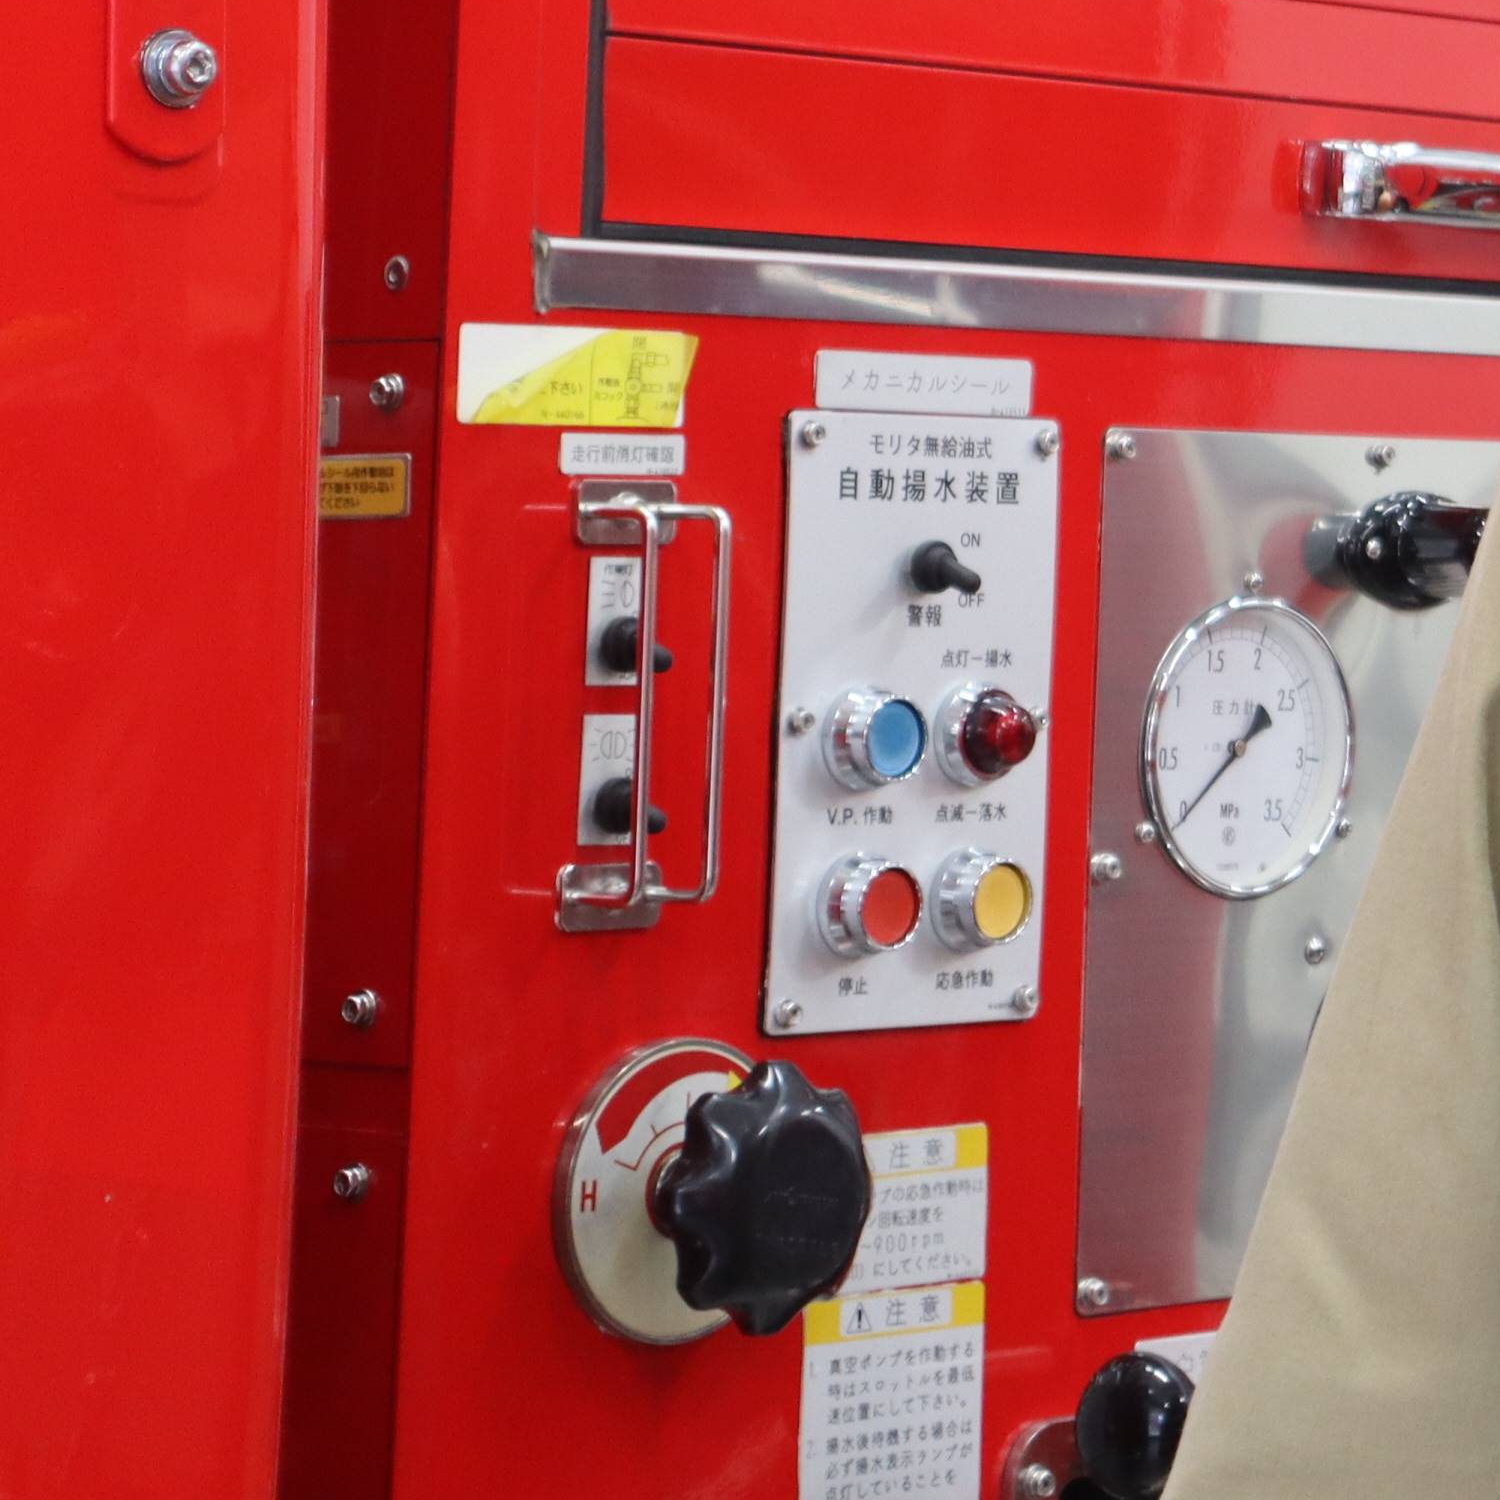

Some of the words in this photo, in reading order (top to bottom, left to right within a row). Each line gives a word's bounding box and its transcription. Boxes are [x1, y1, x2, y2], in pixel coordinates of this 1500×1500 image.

[841, 368, 1010, 396] メカニカルシール
[571, 445, 675, 465] 走行前消灯確認
[870, 434, 992, 459] モリタ無給油式
[839, 466, 1020, 505] 自動揚水装置
[960, 533, 981, 547] ON
[958, 593, 985, 608] OFF
[908, 604, 943, 627] 警報
[1207, 650, 1225, 673] 1.5
[1253, 648, 1262, 671] 2
[1175, 685, 1181, 708] 1
[1277, 689, 1295, 712] 2.5
[1158, 748, 1178, 771] 0.5
[1296, 749, 1304, 769] 3
[827, 808, 857, 825] V.P.
[863, 806, 893, 825] 作動
[1220, 804, 1240, 820] MPa
[1263, 800, 1283, 822] 3.5
[838, 977, 869, 996] 停止
[935, 969, 994, 990] 応急作動
[889, 1137, 944, 1169] 注意
[580, 1180, 598, 1213] H
[886, 1294, 940, 1326] 注意
